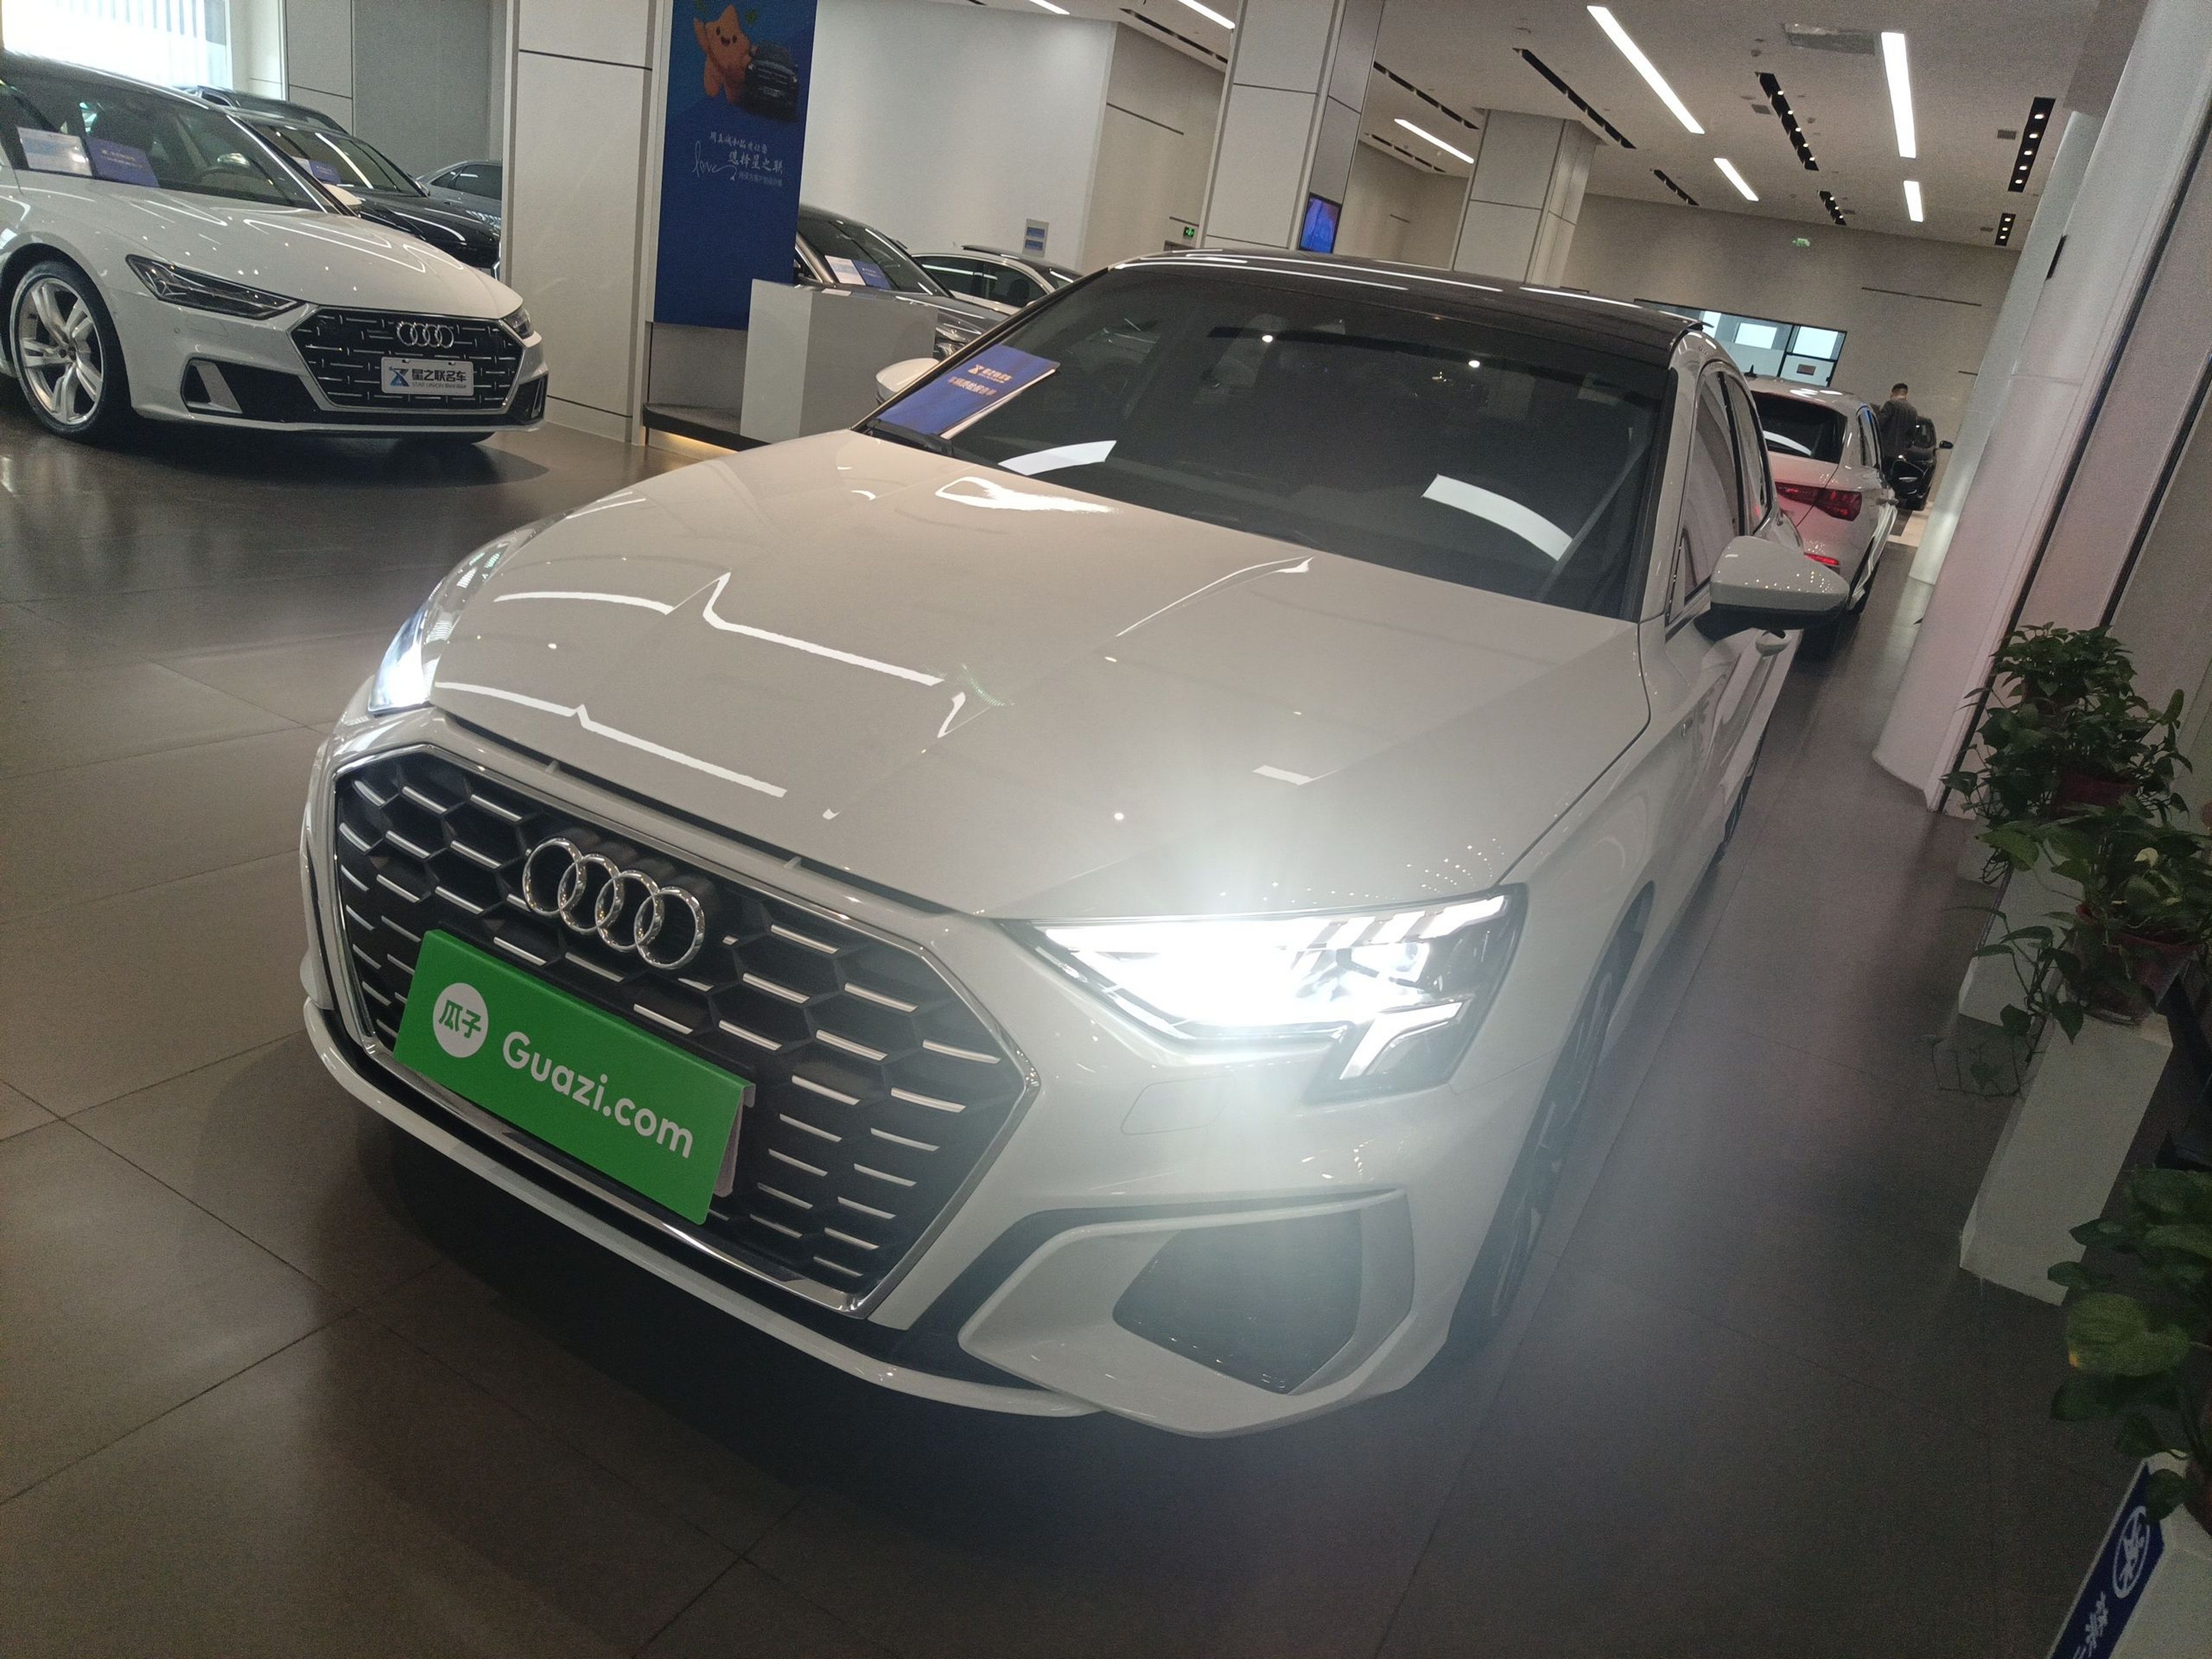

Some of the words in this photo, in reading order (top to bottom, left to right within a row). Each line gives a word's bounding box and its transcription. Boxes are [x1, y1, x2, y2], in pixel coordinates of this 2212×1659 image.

[412, 369, 467, 382] 星之联名车
[438, 999, 482, 1039] 瓜子
[503, 1031, 694, 1158] Guazi.com
